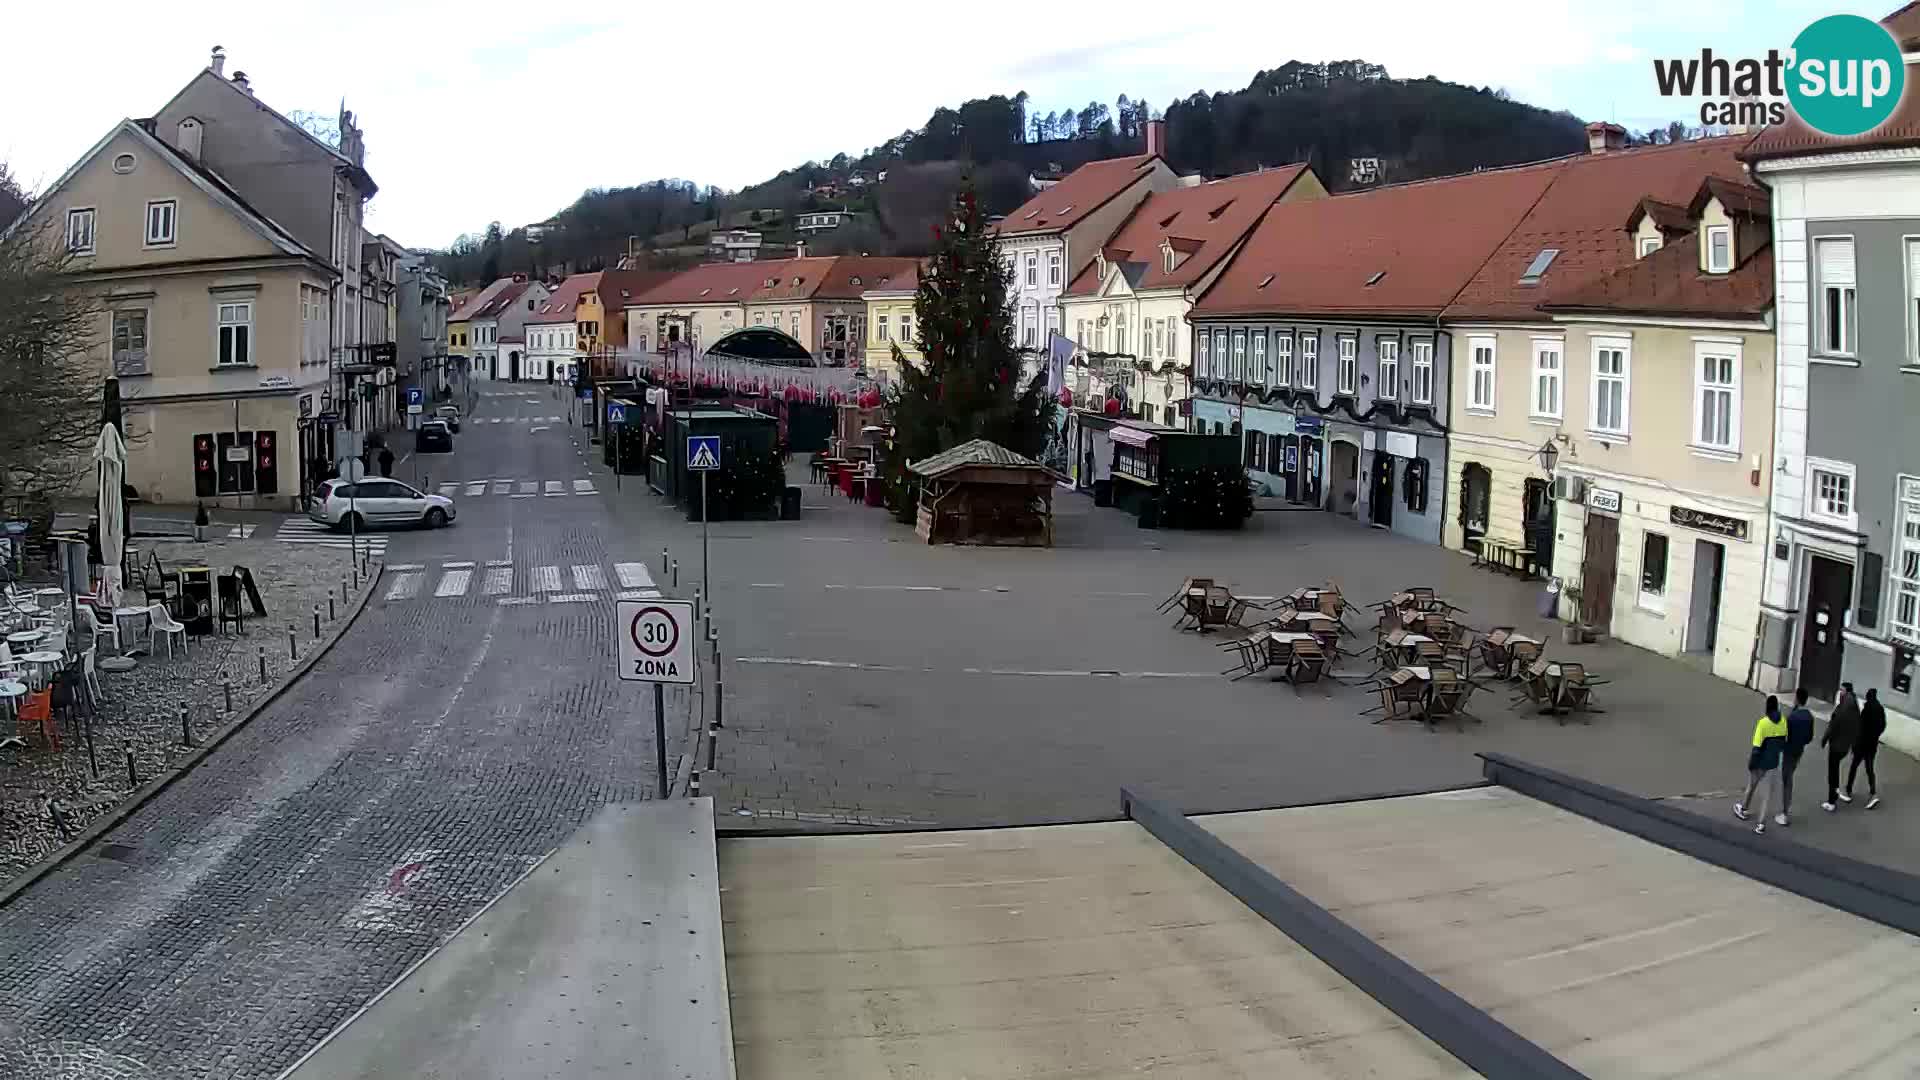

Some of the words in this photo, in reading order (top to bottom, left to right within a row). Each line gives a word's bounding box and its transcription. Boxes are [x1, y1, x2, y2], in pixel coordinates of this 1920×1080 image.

[411, 392, 418, 402] P
[643, 622, 668, 644] 30
[633, 660, 679, 677] ZONA
